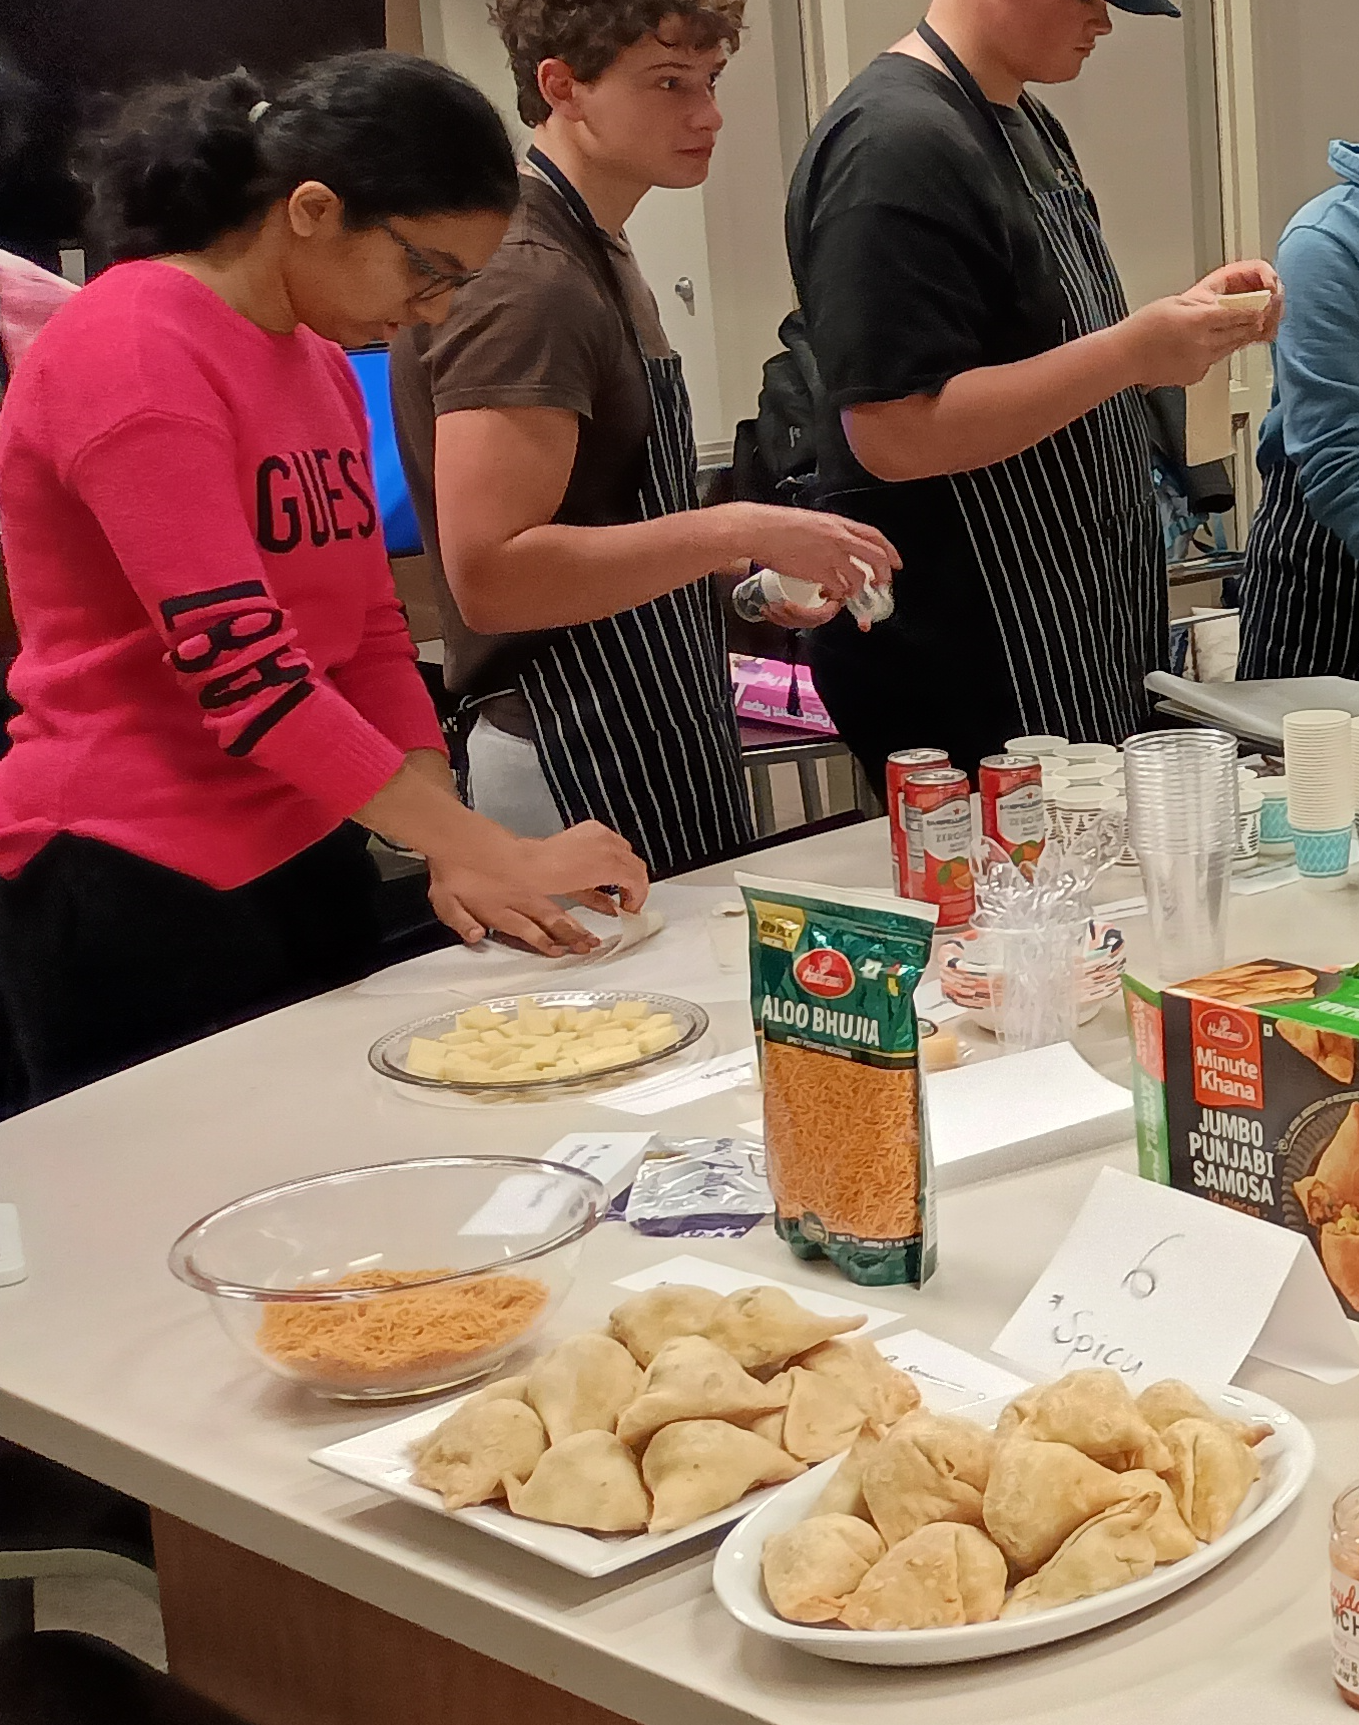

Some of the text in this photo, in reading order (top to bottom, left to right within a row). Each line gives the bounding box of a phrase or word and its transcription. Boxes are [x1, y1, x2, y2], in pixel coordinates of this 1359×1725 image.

[256, 446, 377, 554] GUES
[761, 994, 881, 1047] ALOO BHUJIA
[1195, 1045, 1259, 1081] Minute
[1200, 1069, 1257, 1102] Khana
[1198, 1107, 1264, 1148] JUMBO
[1188, 1131, 1275, 1180] PUNJABI
[1192, 1160, 1275, 1207] SAMOSA
[1121, 1232, 1186, 1300] 6
